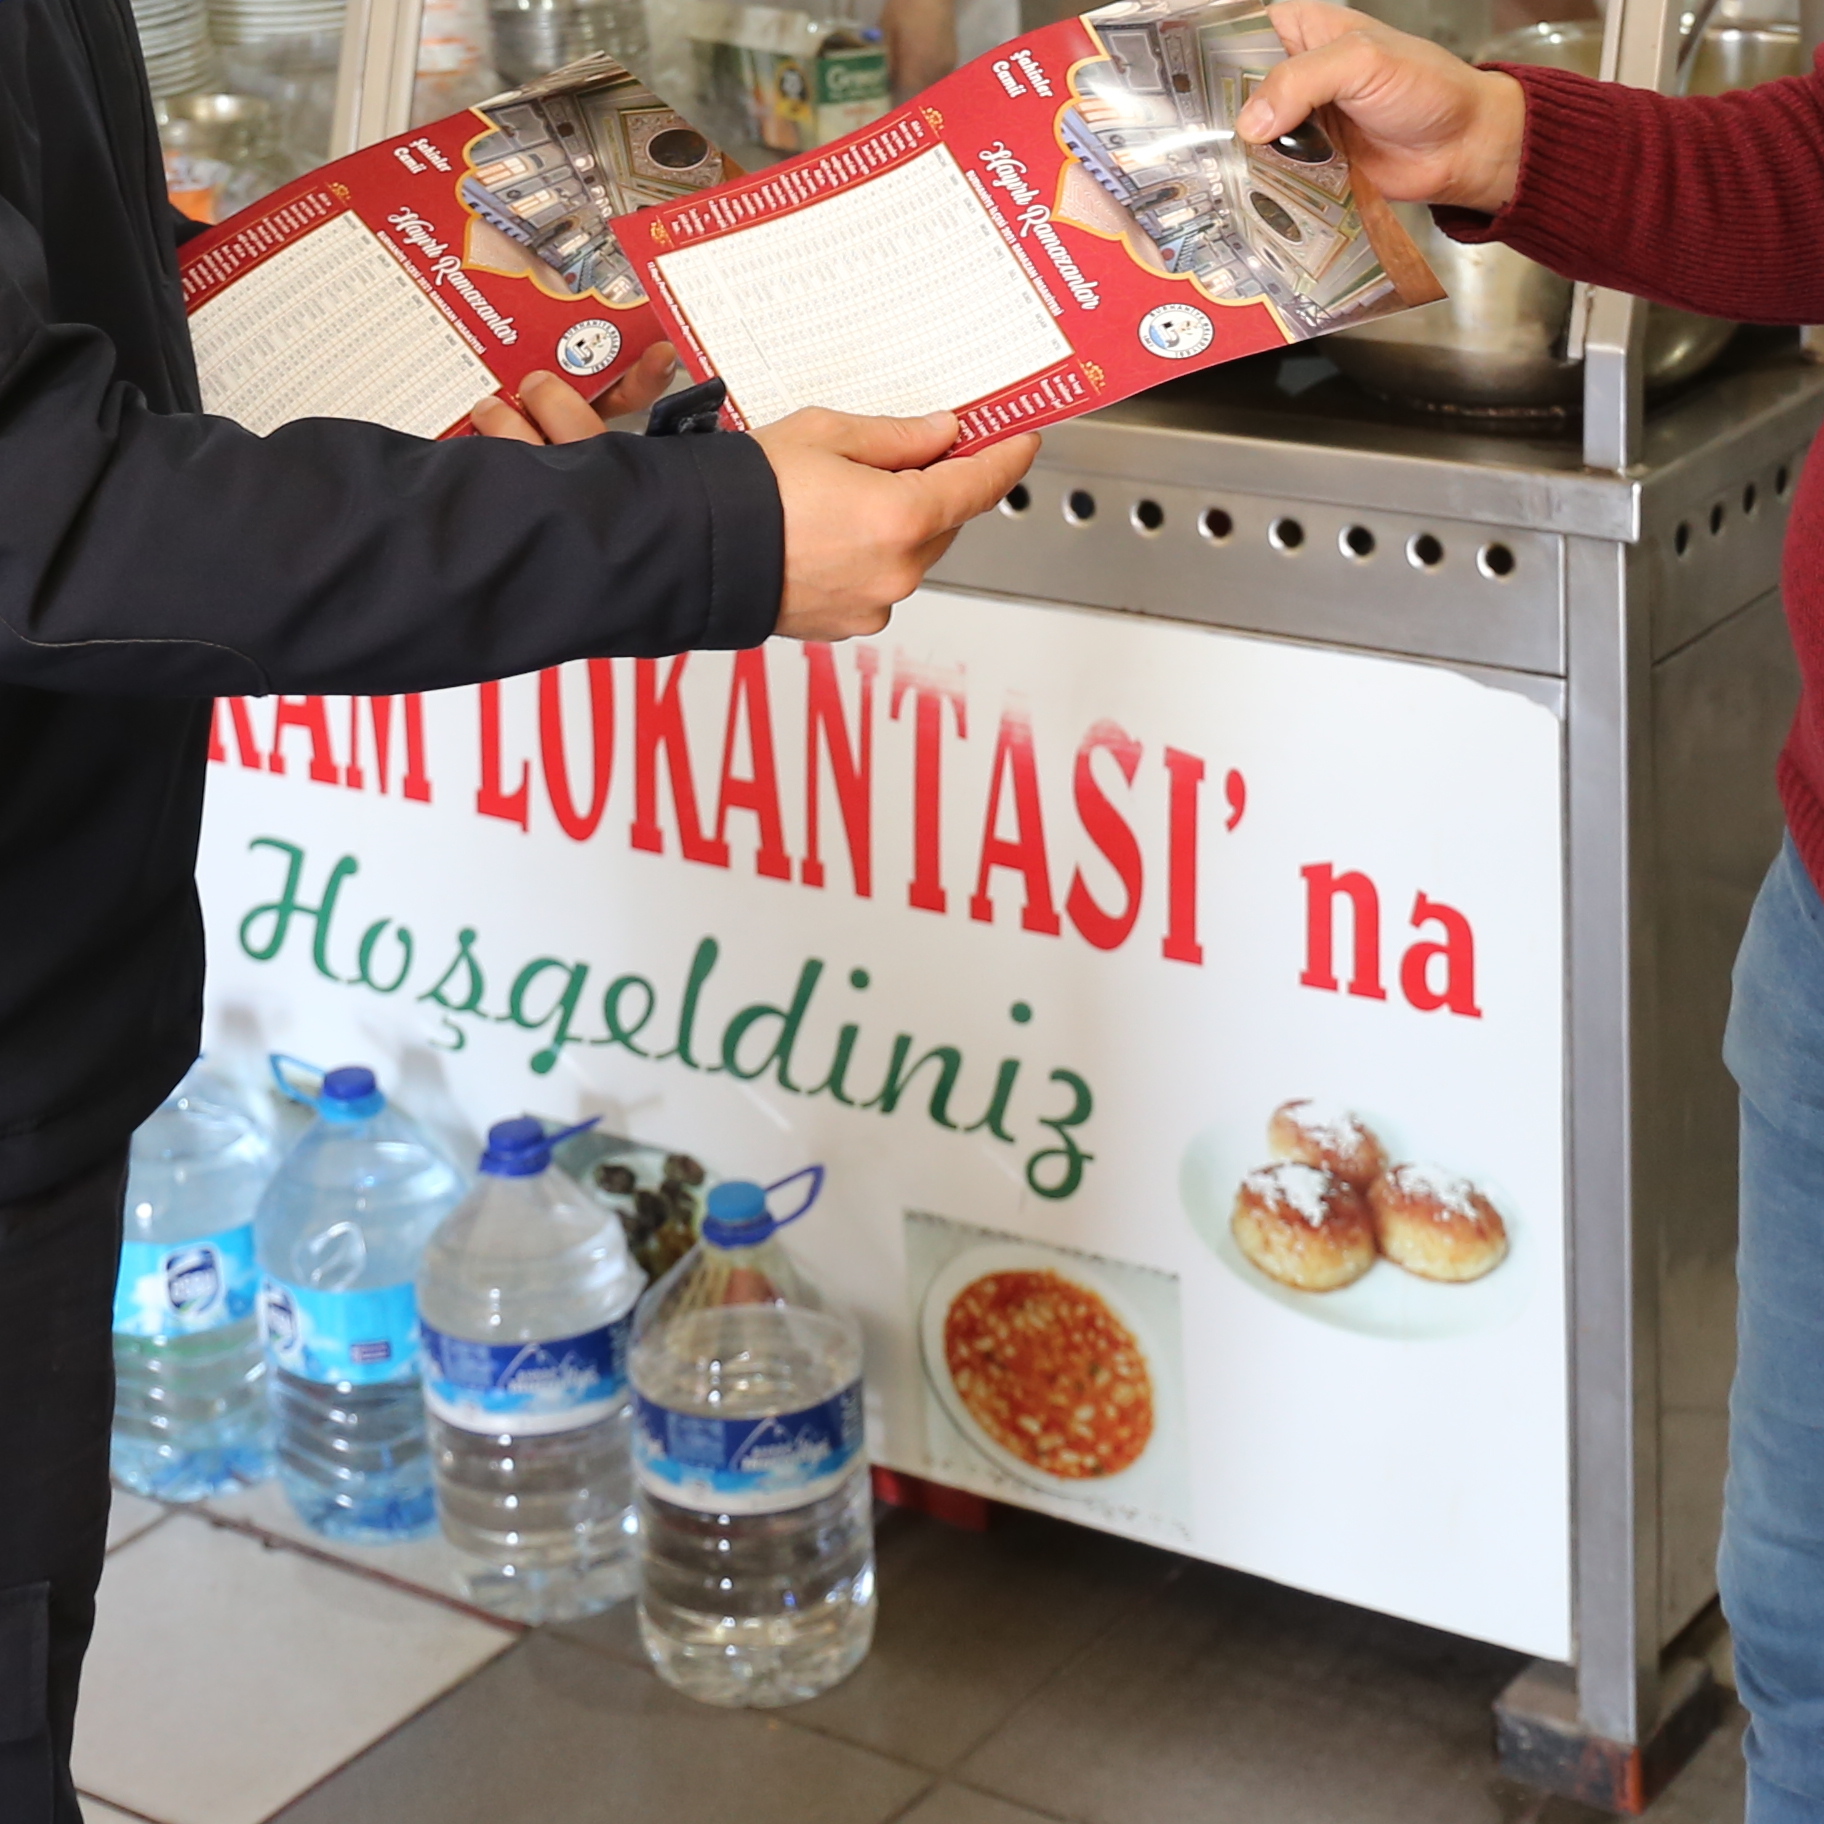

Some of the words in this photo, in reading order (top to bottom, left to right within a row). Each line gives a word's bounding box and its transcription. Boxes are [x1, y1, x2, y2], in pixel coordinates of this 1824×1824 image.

[992, 60, 1027, 98] Camii
[1010, 49, 1054, 98] Şahinler
[393, 147, 427, 174] Camii
[409, 138, 452, 172] Şahinler
[387, 206, 449, 259] Hayırlı
[430, 255, 518, 345] Ramazanlar
[965, 169, 994, 209] BURHANİYE
[1011, 242, 1039, 279] RAMAZAN
[978, 141, 1040, 206] Hayırlı
[1016, 204, 1100, 311] Ramazanlar
[1300, 861, 1483, 1019] na
[238, 835, 1095, 1200] Hoşgeldiniz
